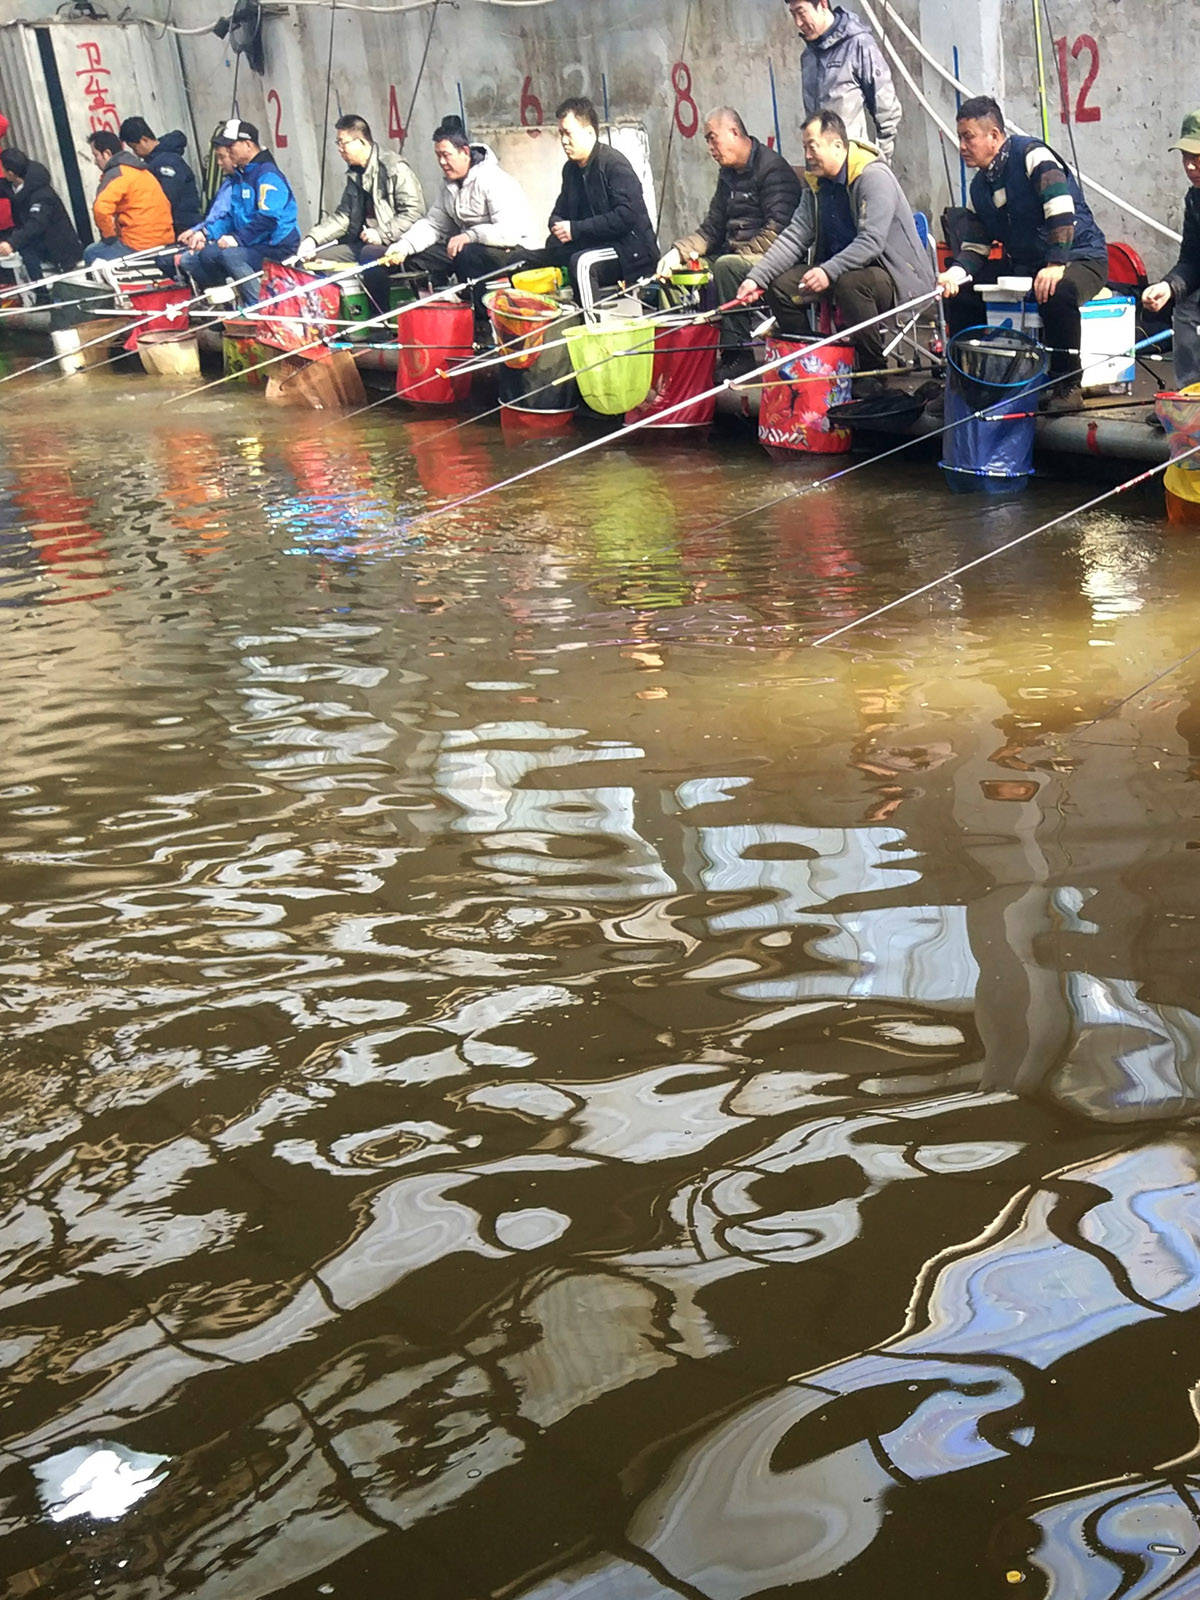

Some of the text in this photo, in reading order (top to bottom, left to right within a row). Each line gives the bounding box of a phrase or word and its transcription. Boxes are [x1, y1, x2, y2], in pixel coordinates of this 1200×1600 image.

[520, 75, 543, 138] 6
[672, 62, 698, 138] 8
[1053, 34, 1101, 124] 12
[267, 89, 288, 148] 2
[388, 84, 408, 152] 4
